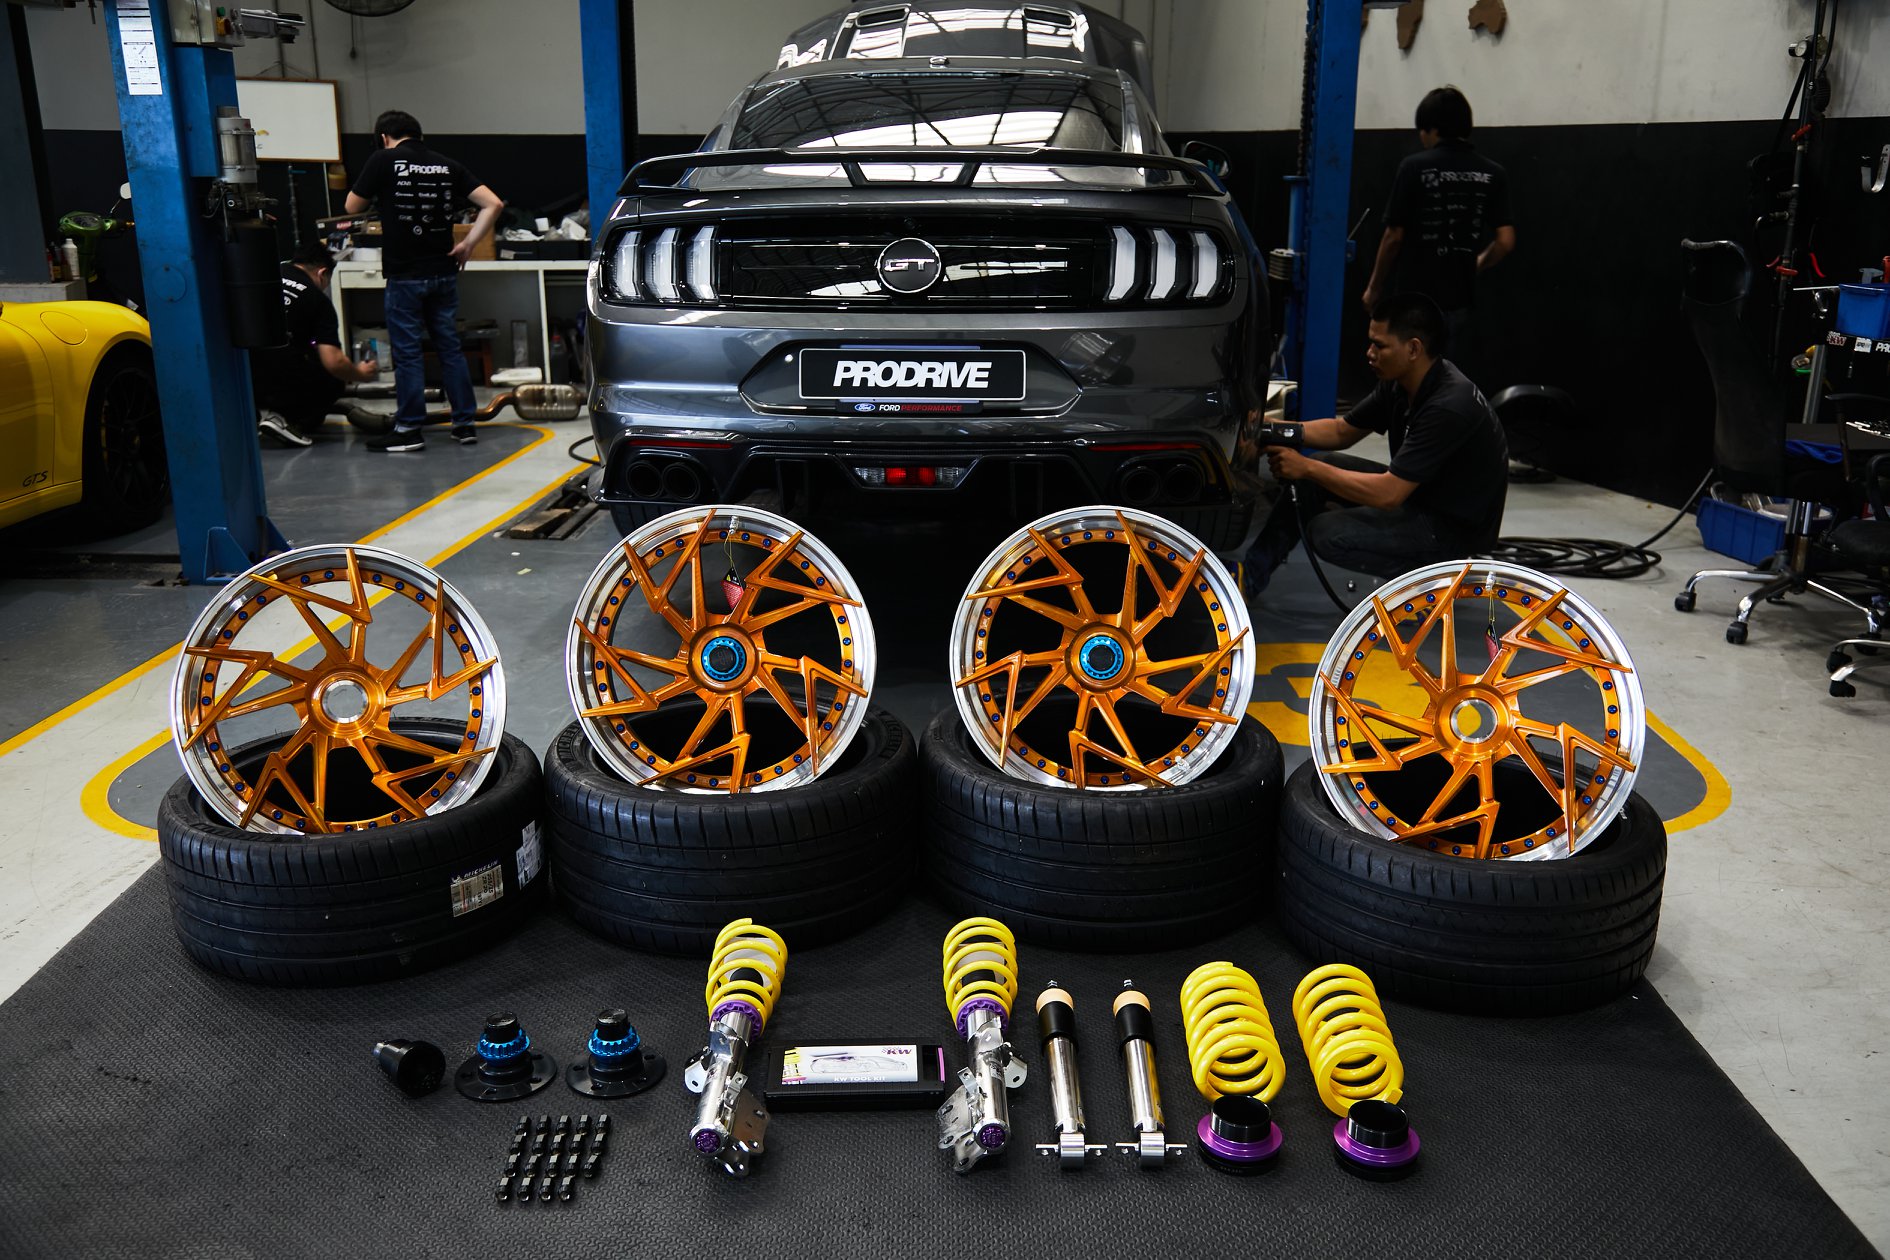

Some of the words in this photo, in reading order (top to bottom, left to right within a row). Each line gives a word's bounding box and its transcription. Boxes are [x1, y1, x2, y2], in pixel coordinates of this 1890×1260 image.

[409, 164, 450, 174] PRODRIVE
[884, 258, 935, 271] GT
[833, 360, 993, 389] PRODRIVE
[879, 404, 901, 412] FORD
[22, 470, 49, 488] GTS
[463, 860, 499, 879] MICHELIN
